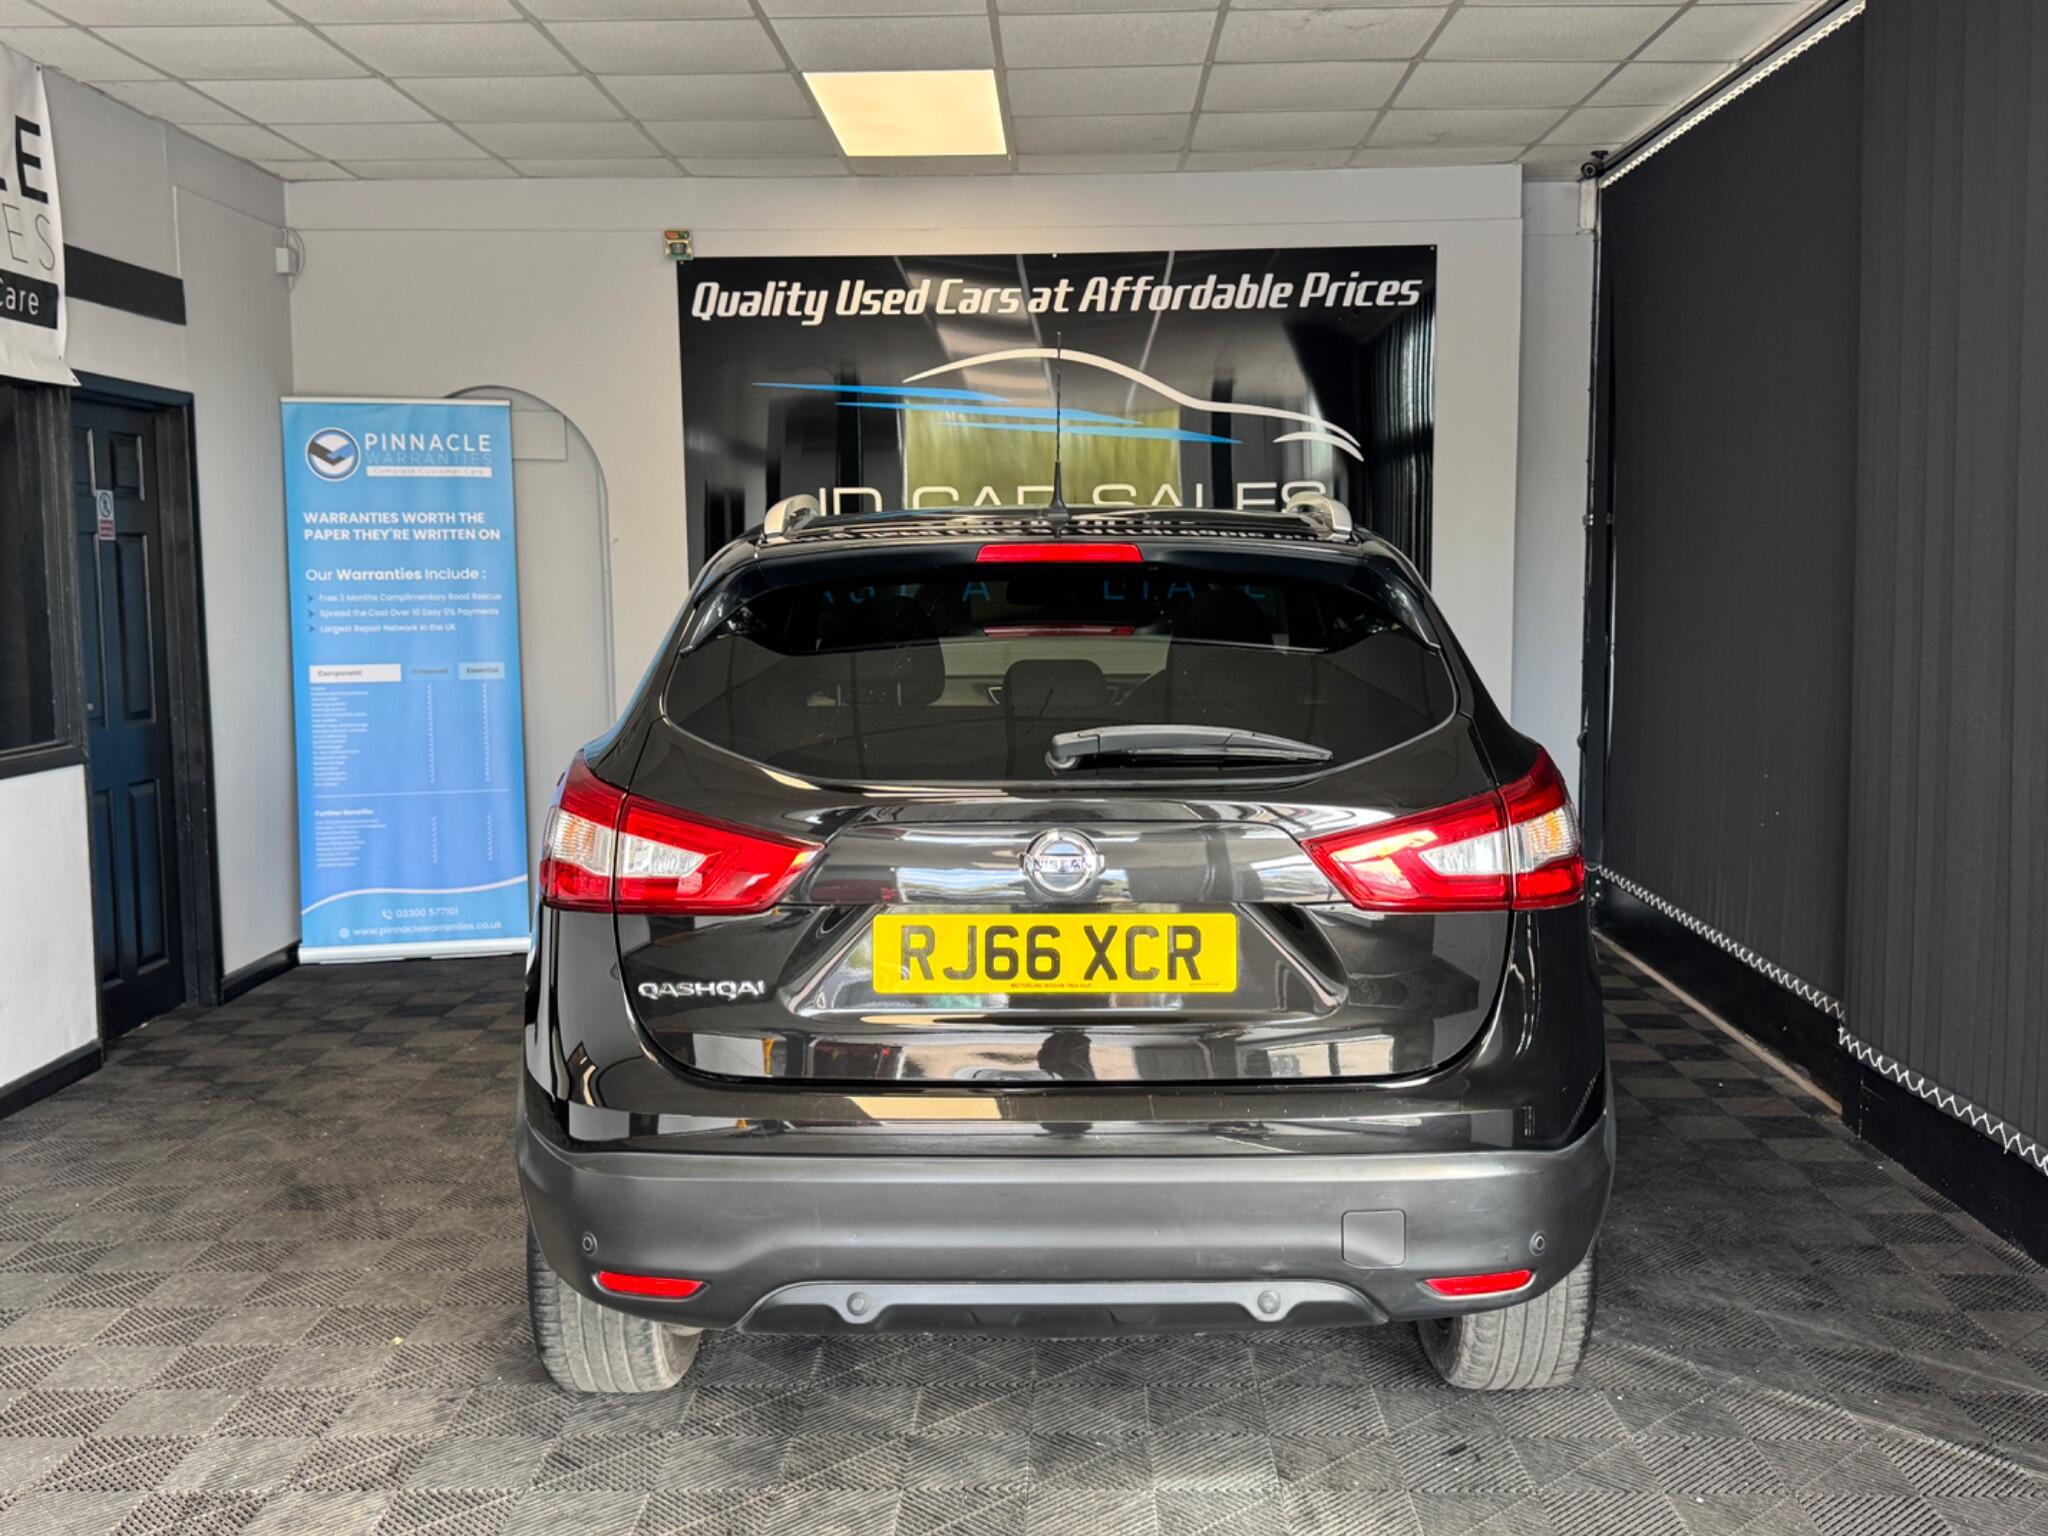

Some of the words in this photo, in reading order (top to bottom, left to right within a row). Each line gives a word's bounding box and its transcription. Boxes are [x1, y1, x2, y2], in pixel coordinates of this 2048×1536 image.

[0, 114, 49, 205] E
[691, 280, 829, 326] Quality
[835, 279, 932, 316] Used
[935, 278, 1022, 314] Cars
[1027, 278, 1075, 313] at
[1078, 273, 1294, 313] Affordable
[1299, 270, 1423, 308] Prices
[365, 432, 492, 452] PINNACLE
[366, 452, 492, 466] WARRANTIES
[303, 511, 399, 524] WARRANTIES
[402, 511, 456, 524] WORTH
[458, 511, 485, 524] THE
[304, 529, 350, 541] PAPER
[352, 528, 410, 541] THEY'RE
[413, 528, 476, 540] WRITTEN
[479, 528, 501, 540] ON
[305, 568, 334, 581] Our
[336, 567, 422, 581] Warranties
[425, 567, 480, 580] Include
[346, 593, 378, 602] Months
[380, 593, 446, 603] Complimentary
[320, 609, 351, 619] Spread
[352, 609, 367, 618] the
[457, 607, 499, 617] Payments
[320, 625, 352, 635] Largest
[353, 624, 381, 634] Repair
[382, 623, 418, 633] Network
[899, 925, 1062, 981] RJ66
[1082, 925, 1202, 981] XCR
[637, 979, 766, 1001] QASHQAI
